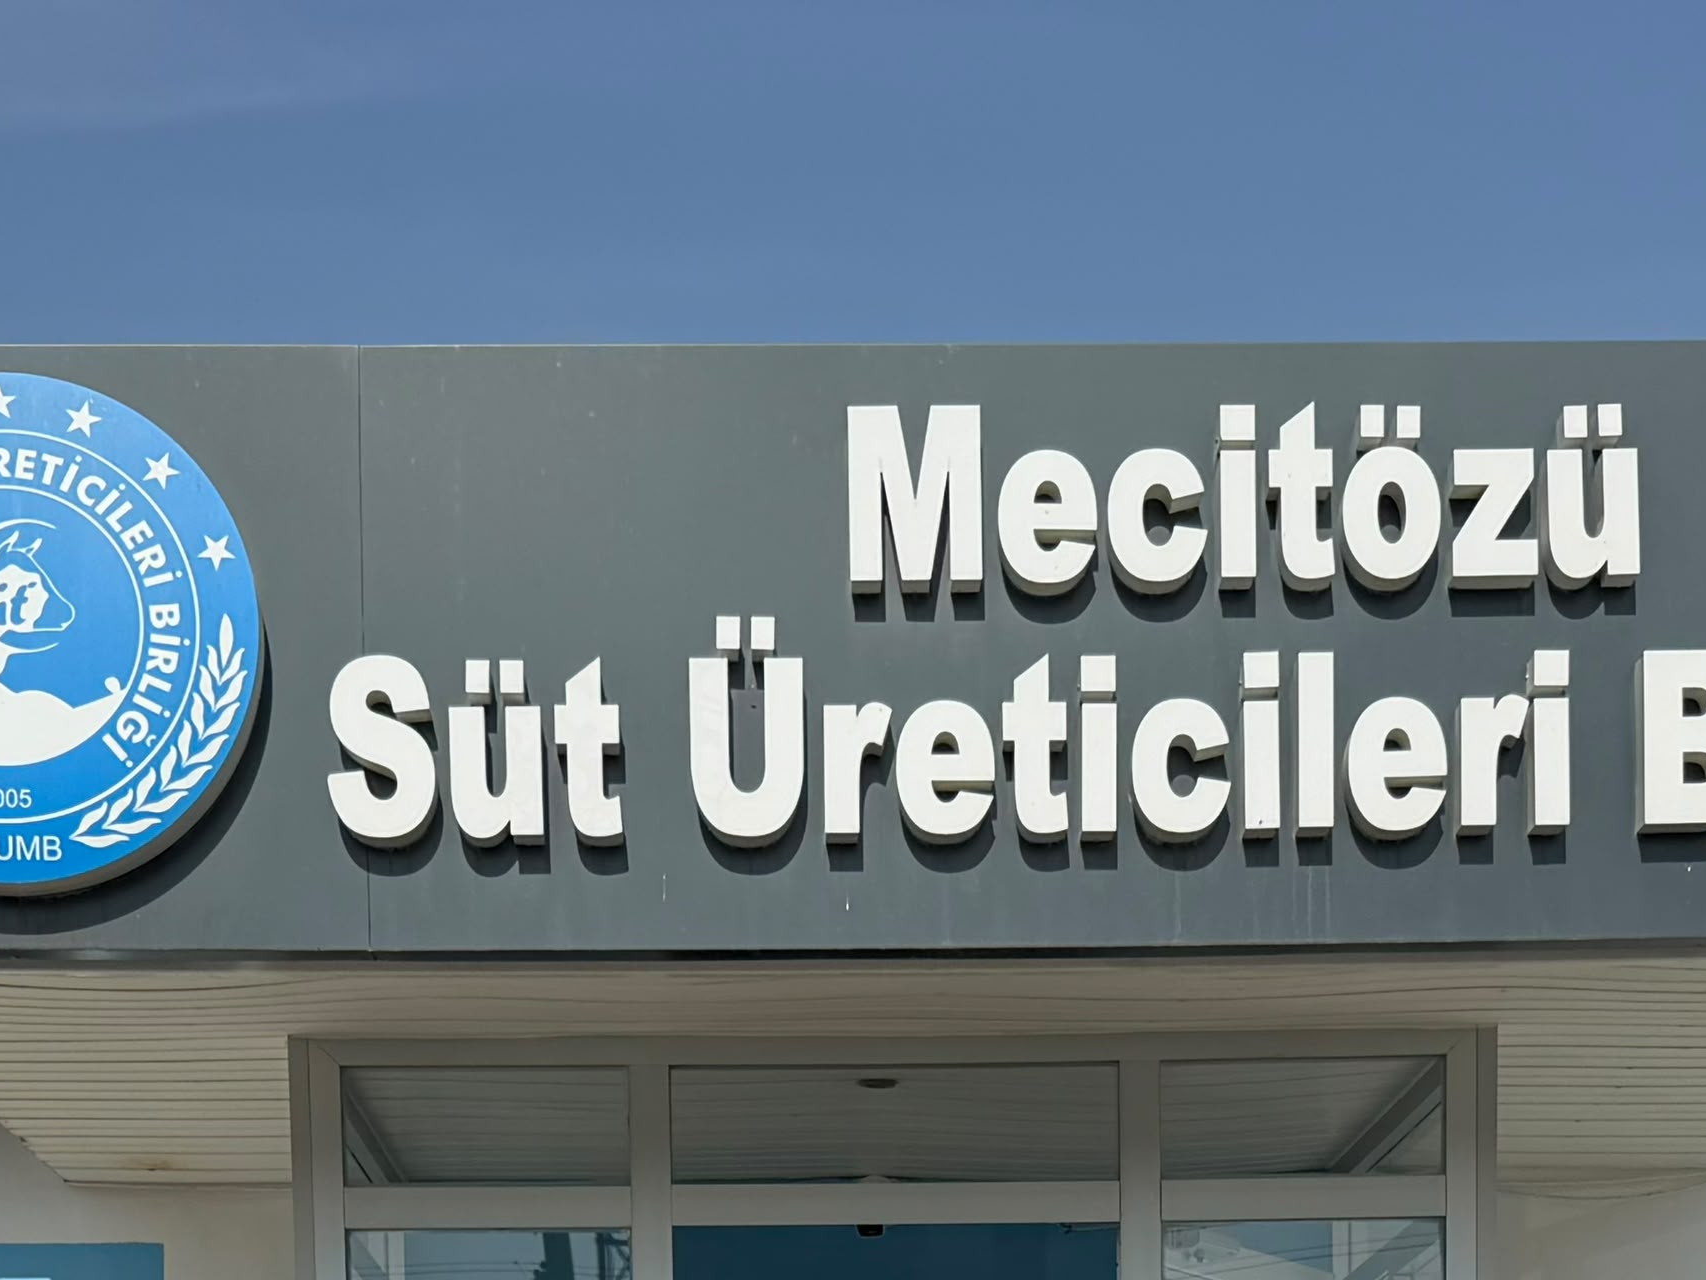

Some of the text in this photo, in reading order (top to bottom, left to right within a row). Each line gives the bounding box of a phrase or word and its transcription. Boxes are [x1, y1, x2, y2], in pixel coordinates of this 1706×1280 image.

[846, 401, 1641, 584] Mecitözü
[101, 602, 191, 769] BİRLİĞİ
[326, 654, 623, 839] Süt
[688, 615, 1571, 838] Üreticileri
